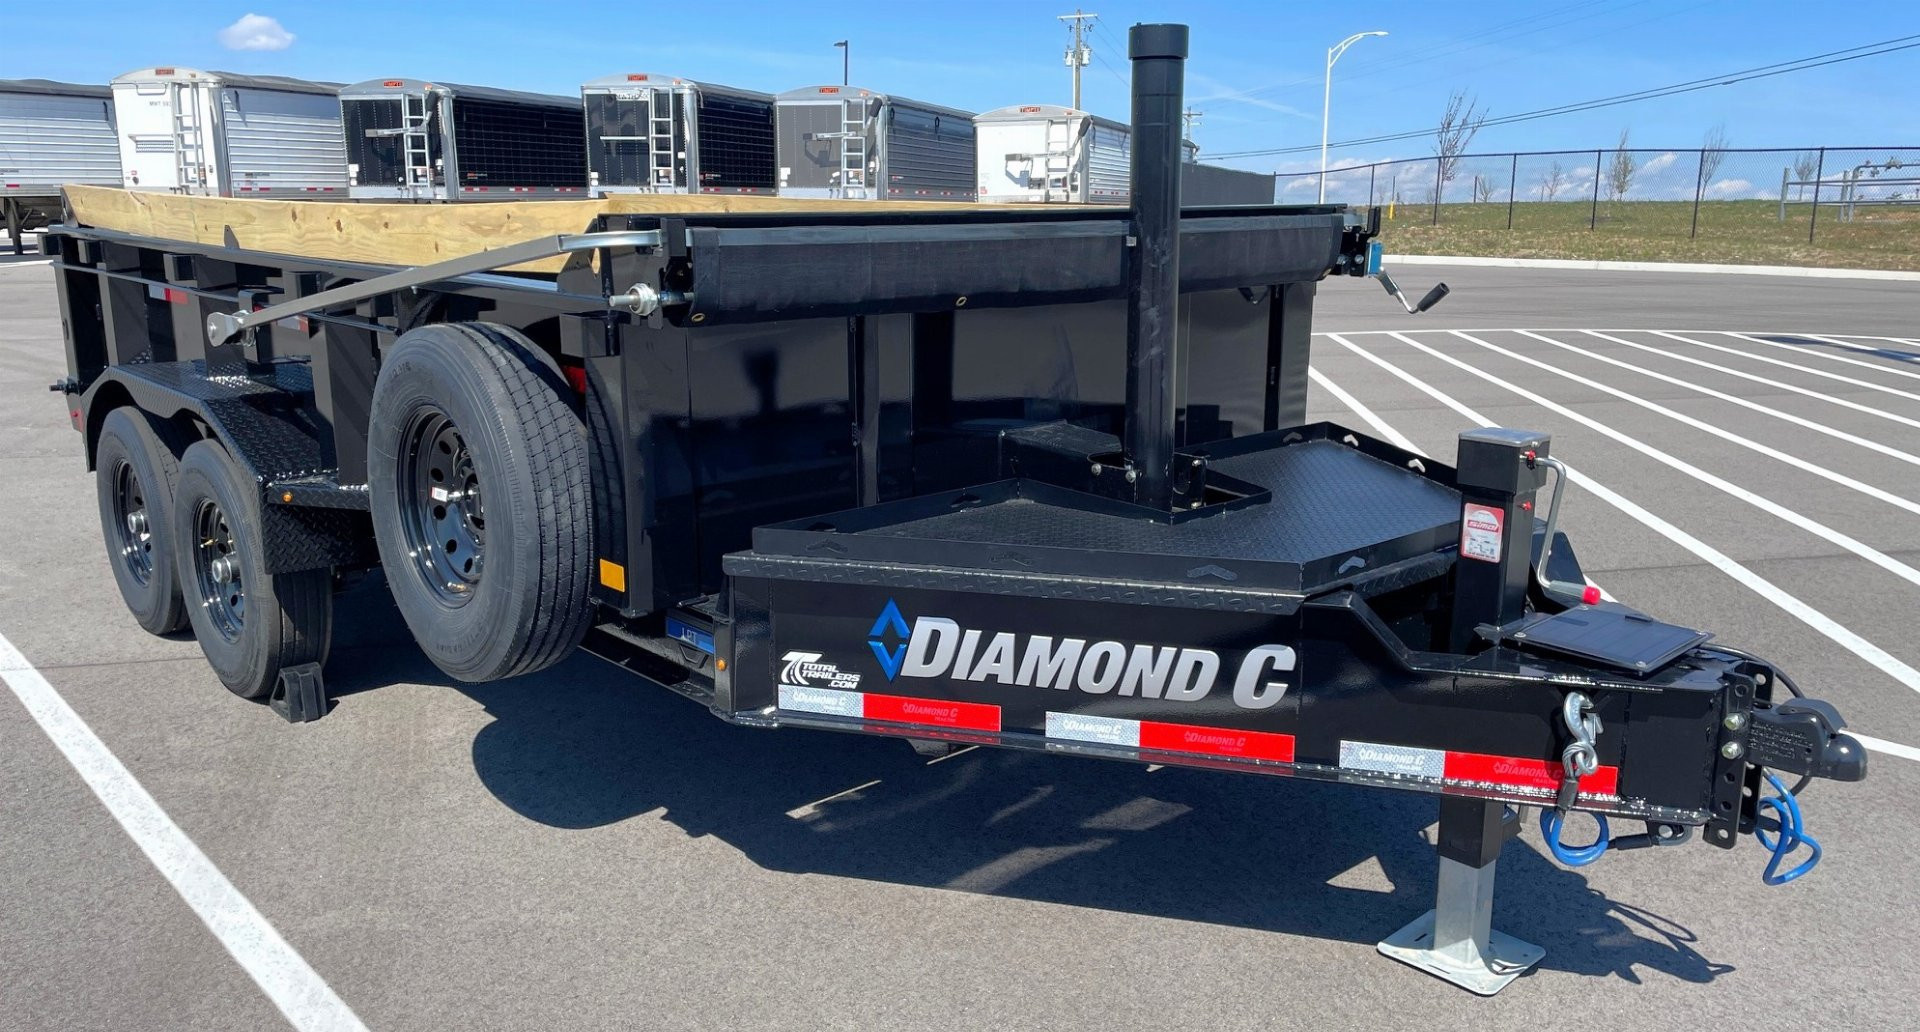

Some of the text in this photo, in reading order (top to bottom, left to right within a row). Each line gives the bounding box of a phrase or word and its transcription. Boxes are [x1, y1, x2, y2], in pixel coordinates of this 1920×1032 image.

[801, 662, 840, 673] TOTAL
[900, 615, 1296, 709] DIAMOND C
[801, 671, 861, 683] TRAILERS
[827, 681, 857, 689] .COM
[907, 703, 958, 717] DIAMOND C
[1069, 720, 1122, 735] DIAMOND C
[1190, 732, 1246, 747] DIAMOND C
[1366, 750, 1425, 765] DIAMOND C
[1500, 763, 1551, 778] DIAMOND
